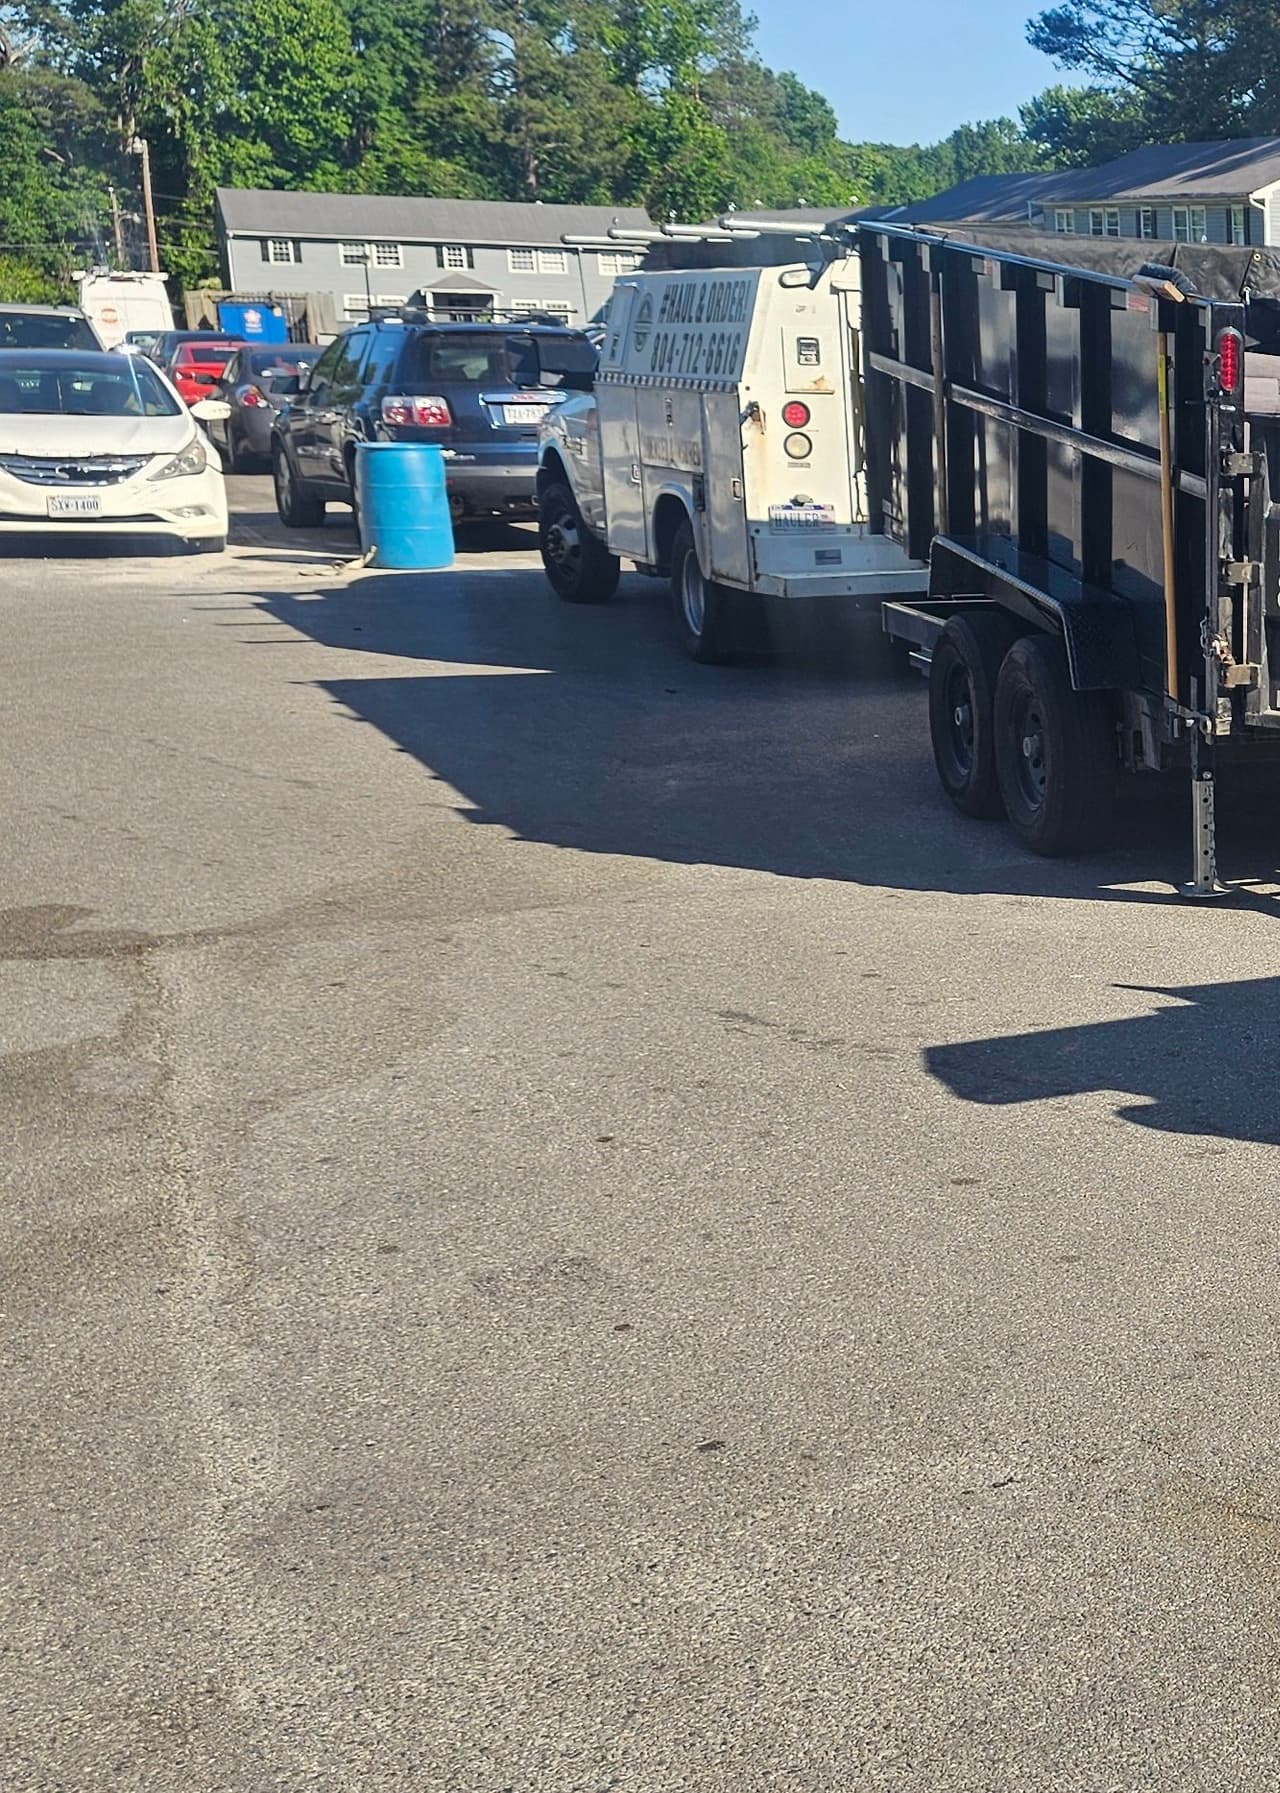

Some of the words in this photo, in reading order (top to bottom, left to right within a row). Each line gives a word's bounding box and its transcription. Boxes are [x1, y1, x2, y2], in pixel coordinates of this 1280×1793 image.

[658, 283, 697, 323] #HAUL
[695, 282, 706, 323] &
[706, 280, 752, 323] ORDER!
[650, 331, 742, 375] 804-712-6616
[774, 513, 819, 528] HAULER
